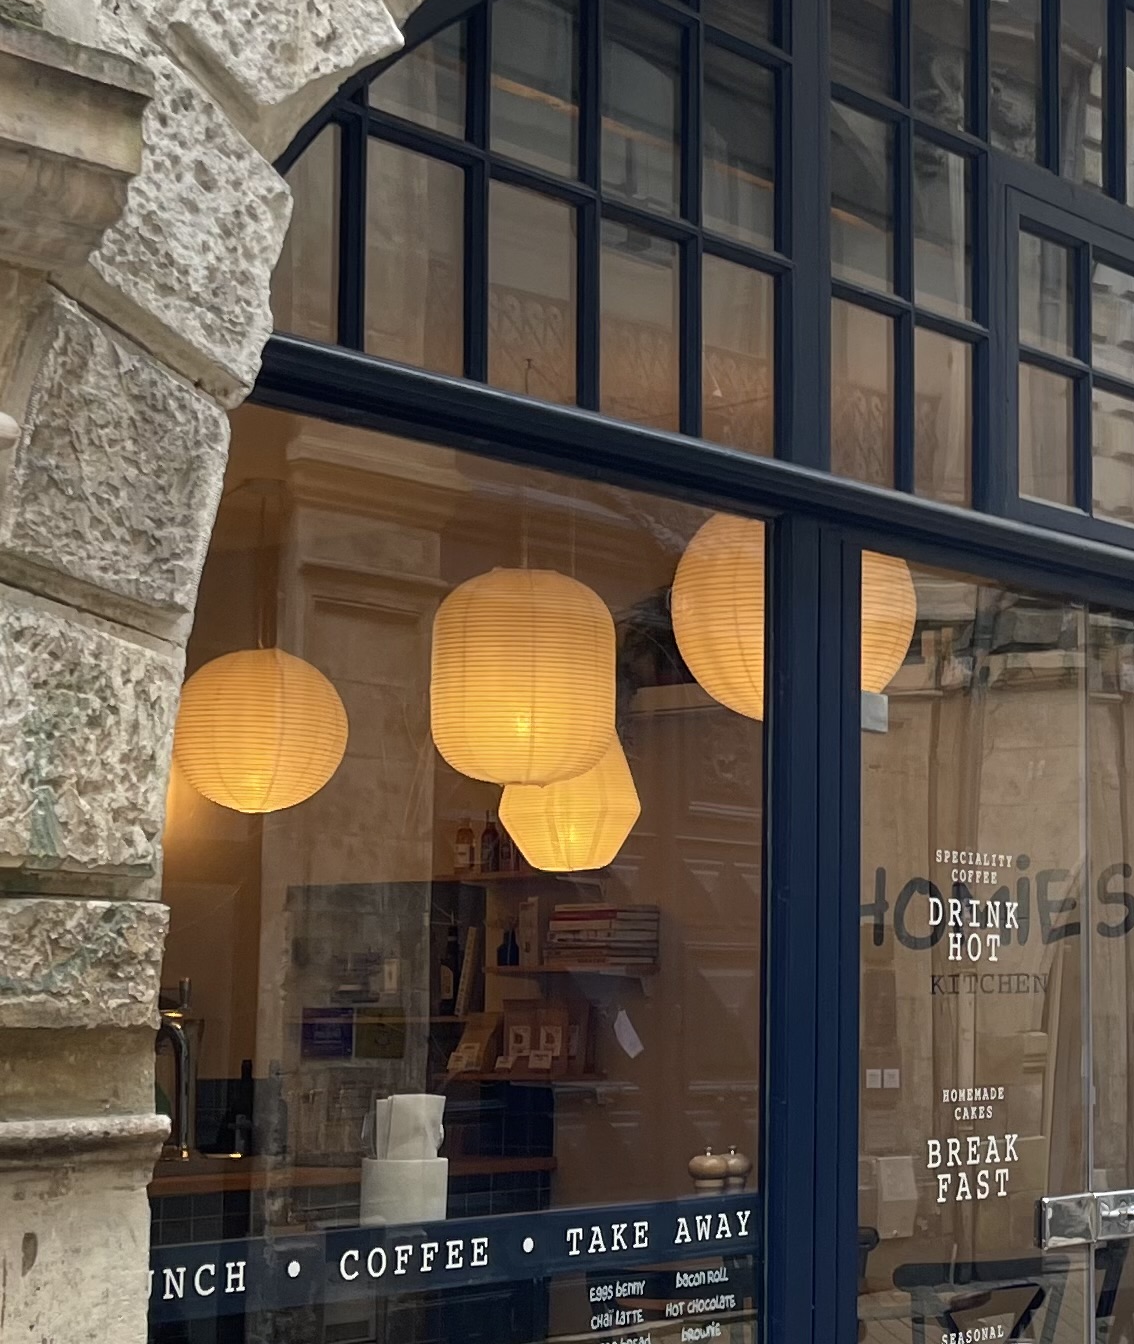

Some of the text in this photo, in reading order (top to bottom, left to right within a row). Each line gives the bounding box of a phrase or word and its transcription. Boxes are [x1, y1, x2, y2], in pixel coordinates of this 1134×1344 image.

[935, 849, 1013, 868] SPECIALITY
[951, 868, 998, 885] COFFEE
[928, 896, 1020, 930] DRINK
[948, 932, 1001, 962] HOT
[930, 972, 1050, 996] KITCHEN
[941, 1086, 1005, 1103] HOMEMADE
[954, 1104, 994, 1121] CAKES
[926, 1133, 1020, 1169] BREAK
[936, 1167, 1011, 1204] FAST
[339, 1237, 490, 1282] COFFEE
[566, 1220, 650, 1256] TAKE
[674, 1210, 751, 1244] AWAY
